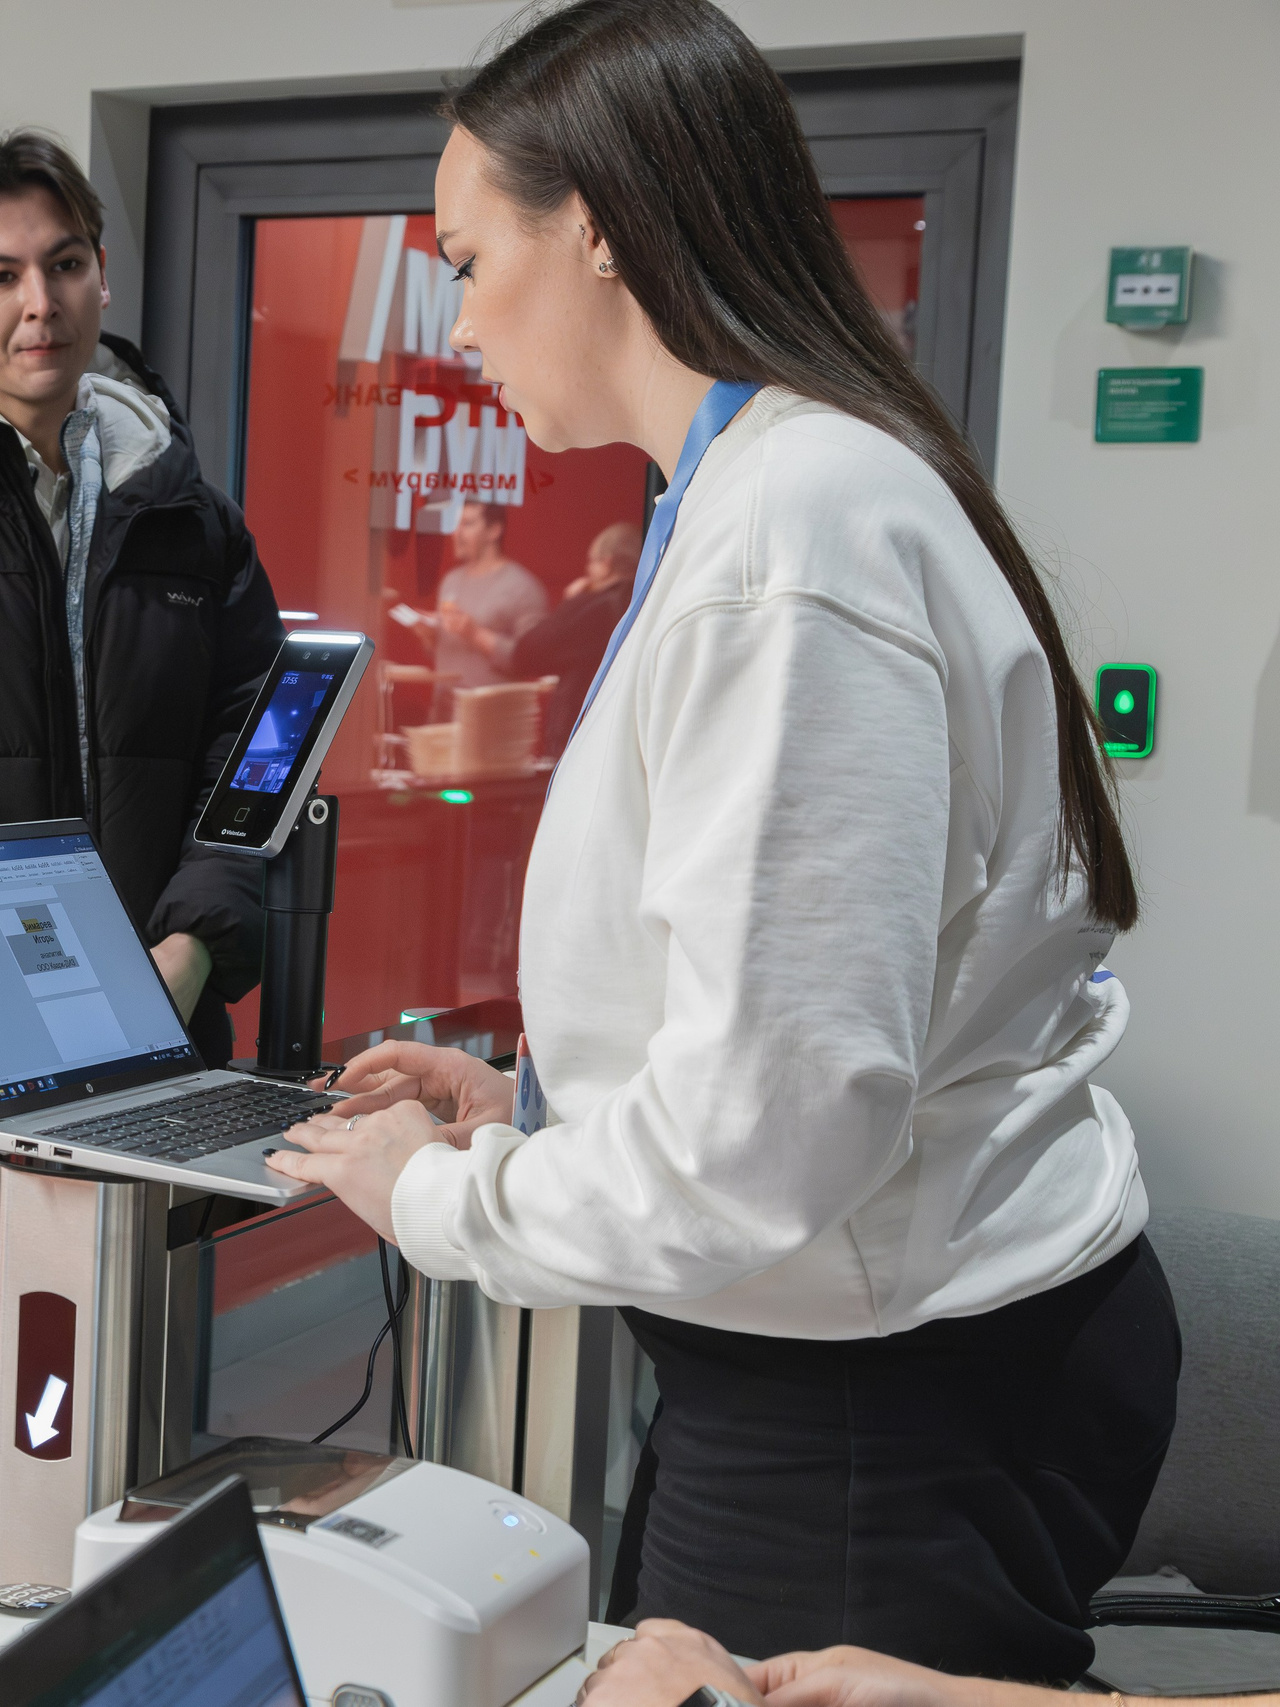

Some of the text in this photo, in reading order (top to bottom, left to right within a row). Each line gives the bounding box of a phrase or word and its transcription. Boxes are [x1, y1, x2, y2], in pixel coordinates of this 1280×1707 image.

[281, 676, 299, 685] 17:55
[33, 935, 54, 944] Игорь
[0, 1586, 52, 1603] TECH
[18, 1588, 72, 1609] TRUE
